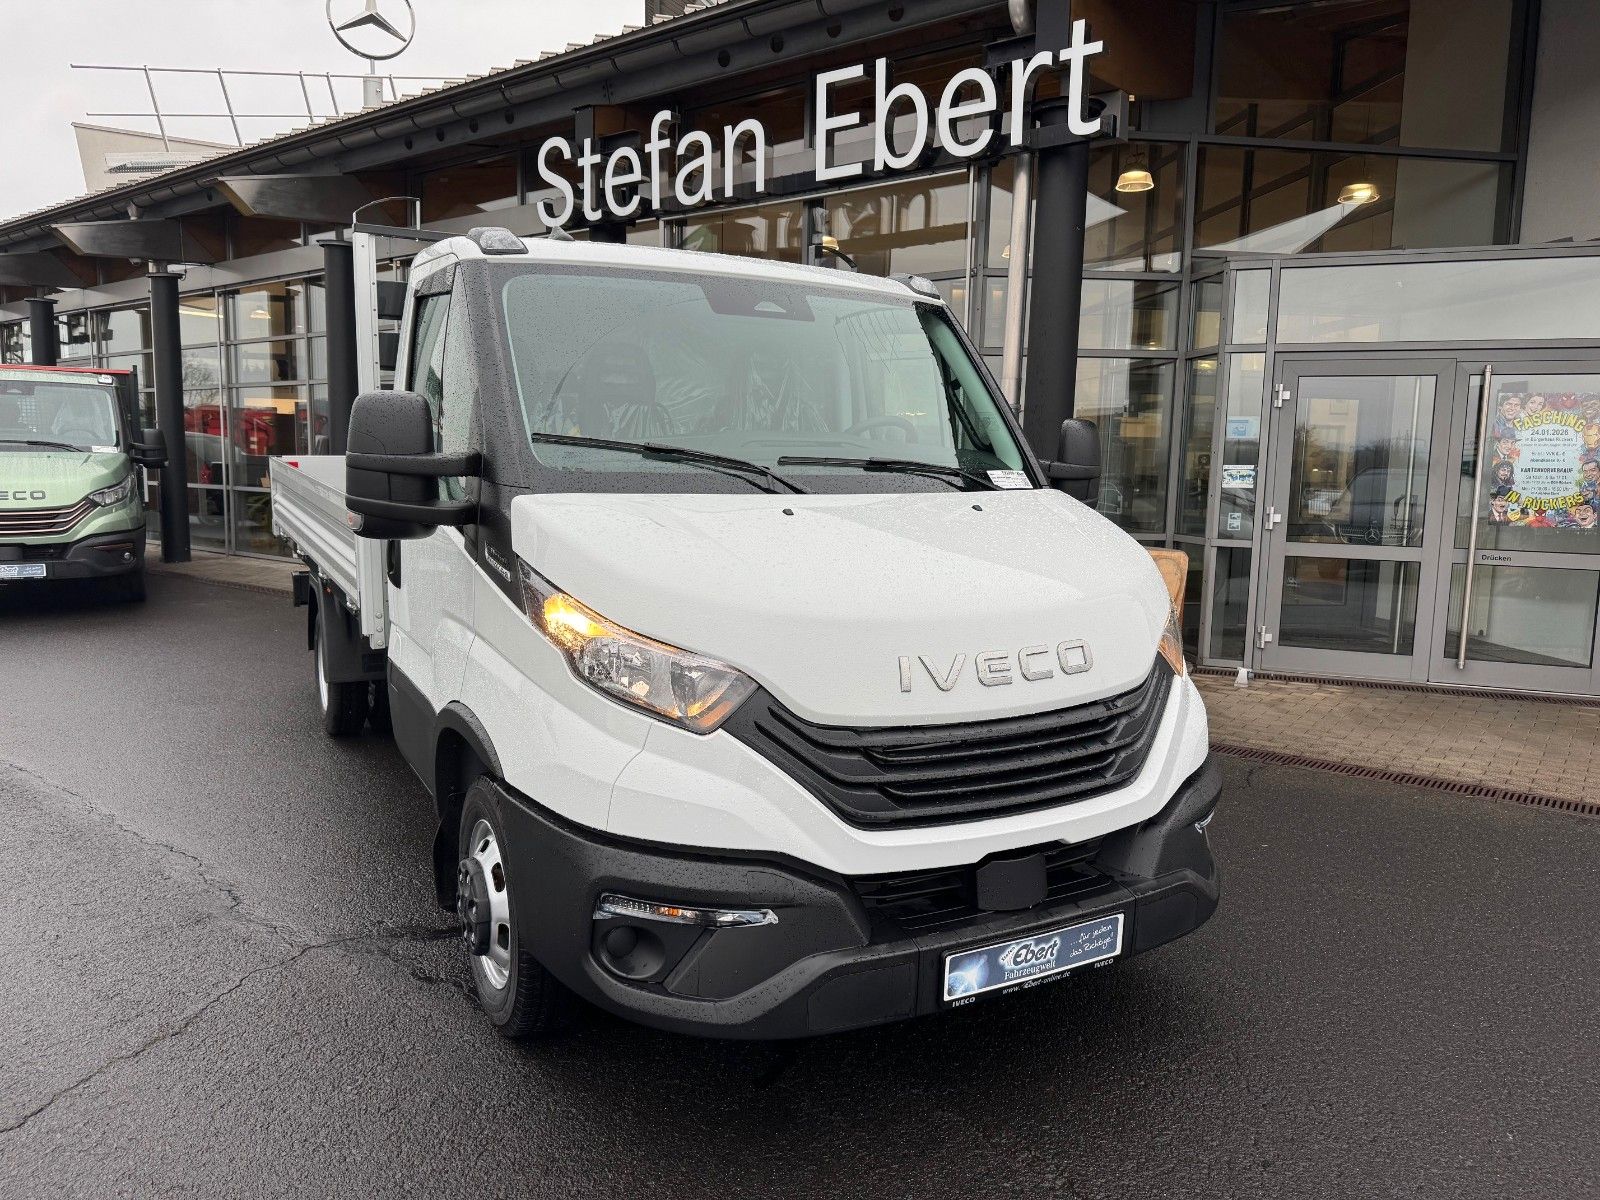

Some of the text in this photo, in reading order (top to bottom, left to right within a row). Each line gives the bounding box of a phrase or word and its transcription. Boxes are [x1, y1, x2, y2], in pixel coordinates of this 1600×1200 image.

[536, 19, 1105, 228] Stefan Ebert
[1513, 410, 1587, 433] FASCHING
[1504, 490, 1521, 504] IN
[1481, 554, 1512, 562] Drücken
[898, 638, 1094, 693] IVECO
[1012, 939, 1059, 967] Ebert
[1070, 948, 1083, 958] das
[1004, 960, 1057, 980] Fahrzeugwelt
[1094, 958, 1114, 968] IVECO
[951, 995, 976, 1008] IVECO
